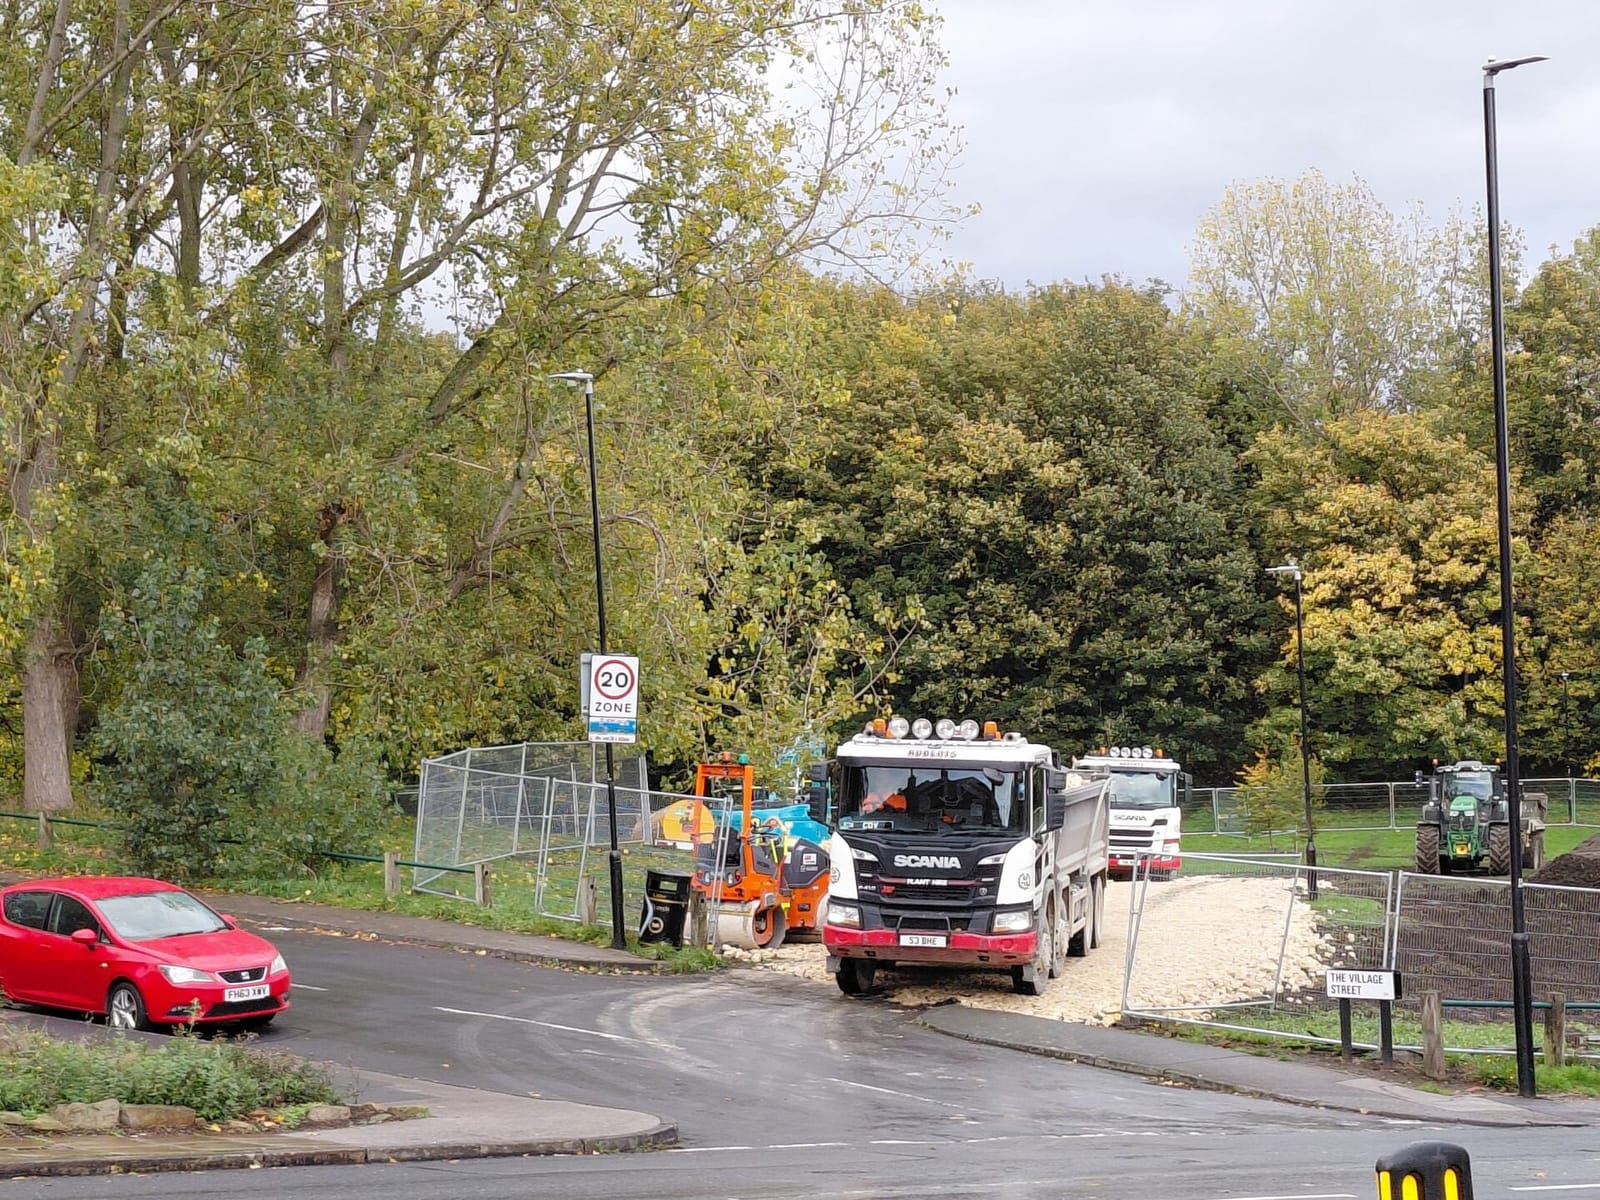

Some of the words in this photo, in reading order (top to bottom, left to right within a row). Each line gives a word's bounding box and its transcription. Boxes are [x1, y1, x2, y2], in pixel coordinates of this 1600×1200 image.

[601, 671, 628, 688] 20
[595, 702, 632, 713] ZONE
[893, 855, 961, 869] SCANIA
[906, 878, 931, 886] PLANT
[1330, 973, 1347, 982] THE
[1348, 973, 1384, 984] VILLAGE
[228, 989, 250, 999] FH63
[1330, 984, 1361, 995] STREET
